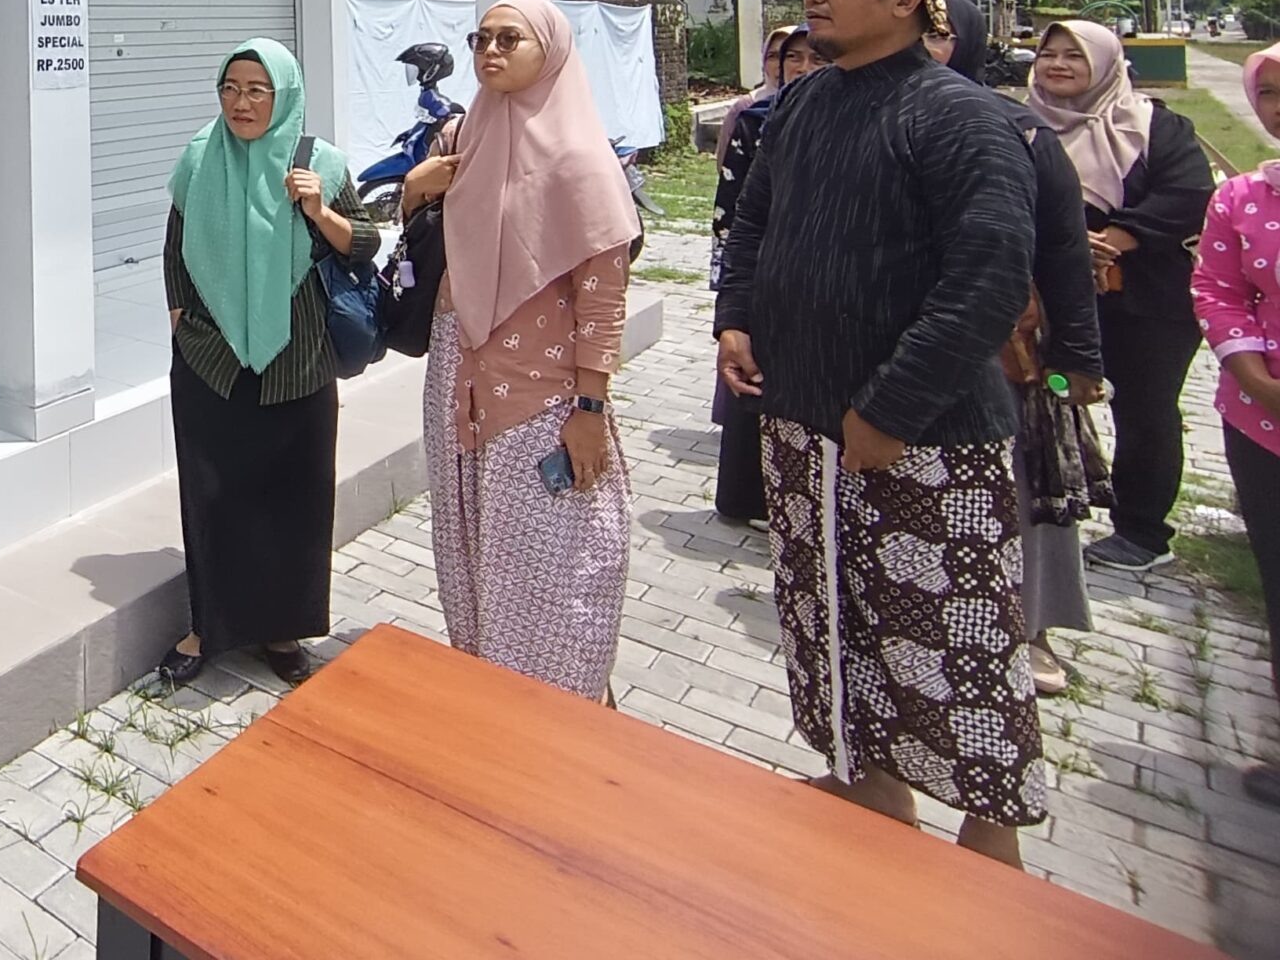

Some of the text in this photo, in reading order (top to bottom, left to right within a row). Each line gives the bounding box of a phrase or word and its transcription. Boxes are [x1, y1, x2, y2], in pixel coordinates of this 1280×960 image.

[40, 15, 80, 26] JUMBO
[37, 36, 84, 48] SPECIAL
[37, 58, 84, 72] RP.2500
